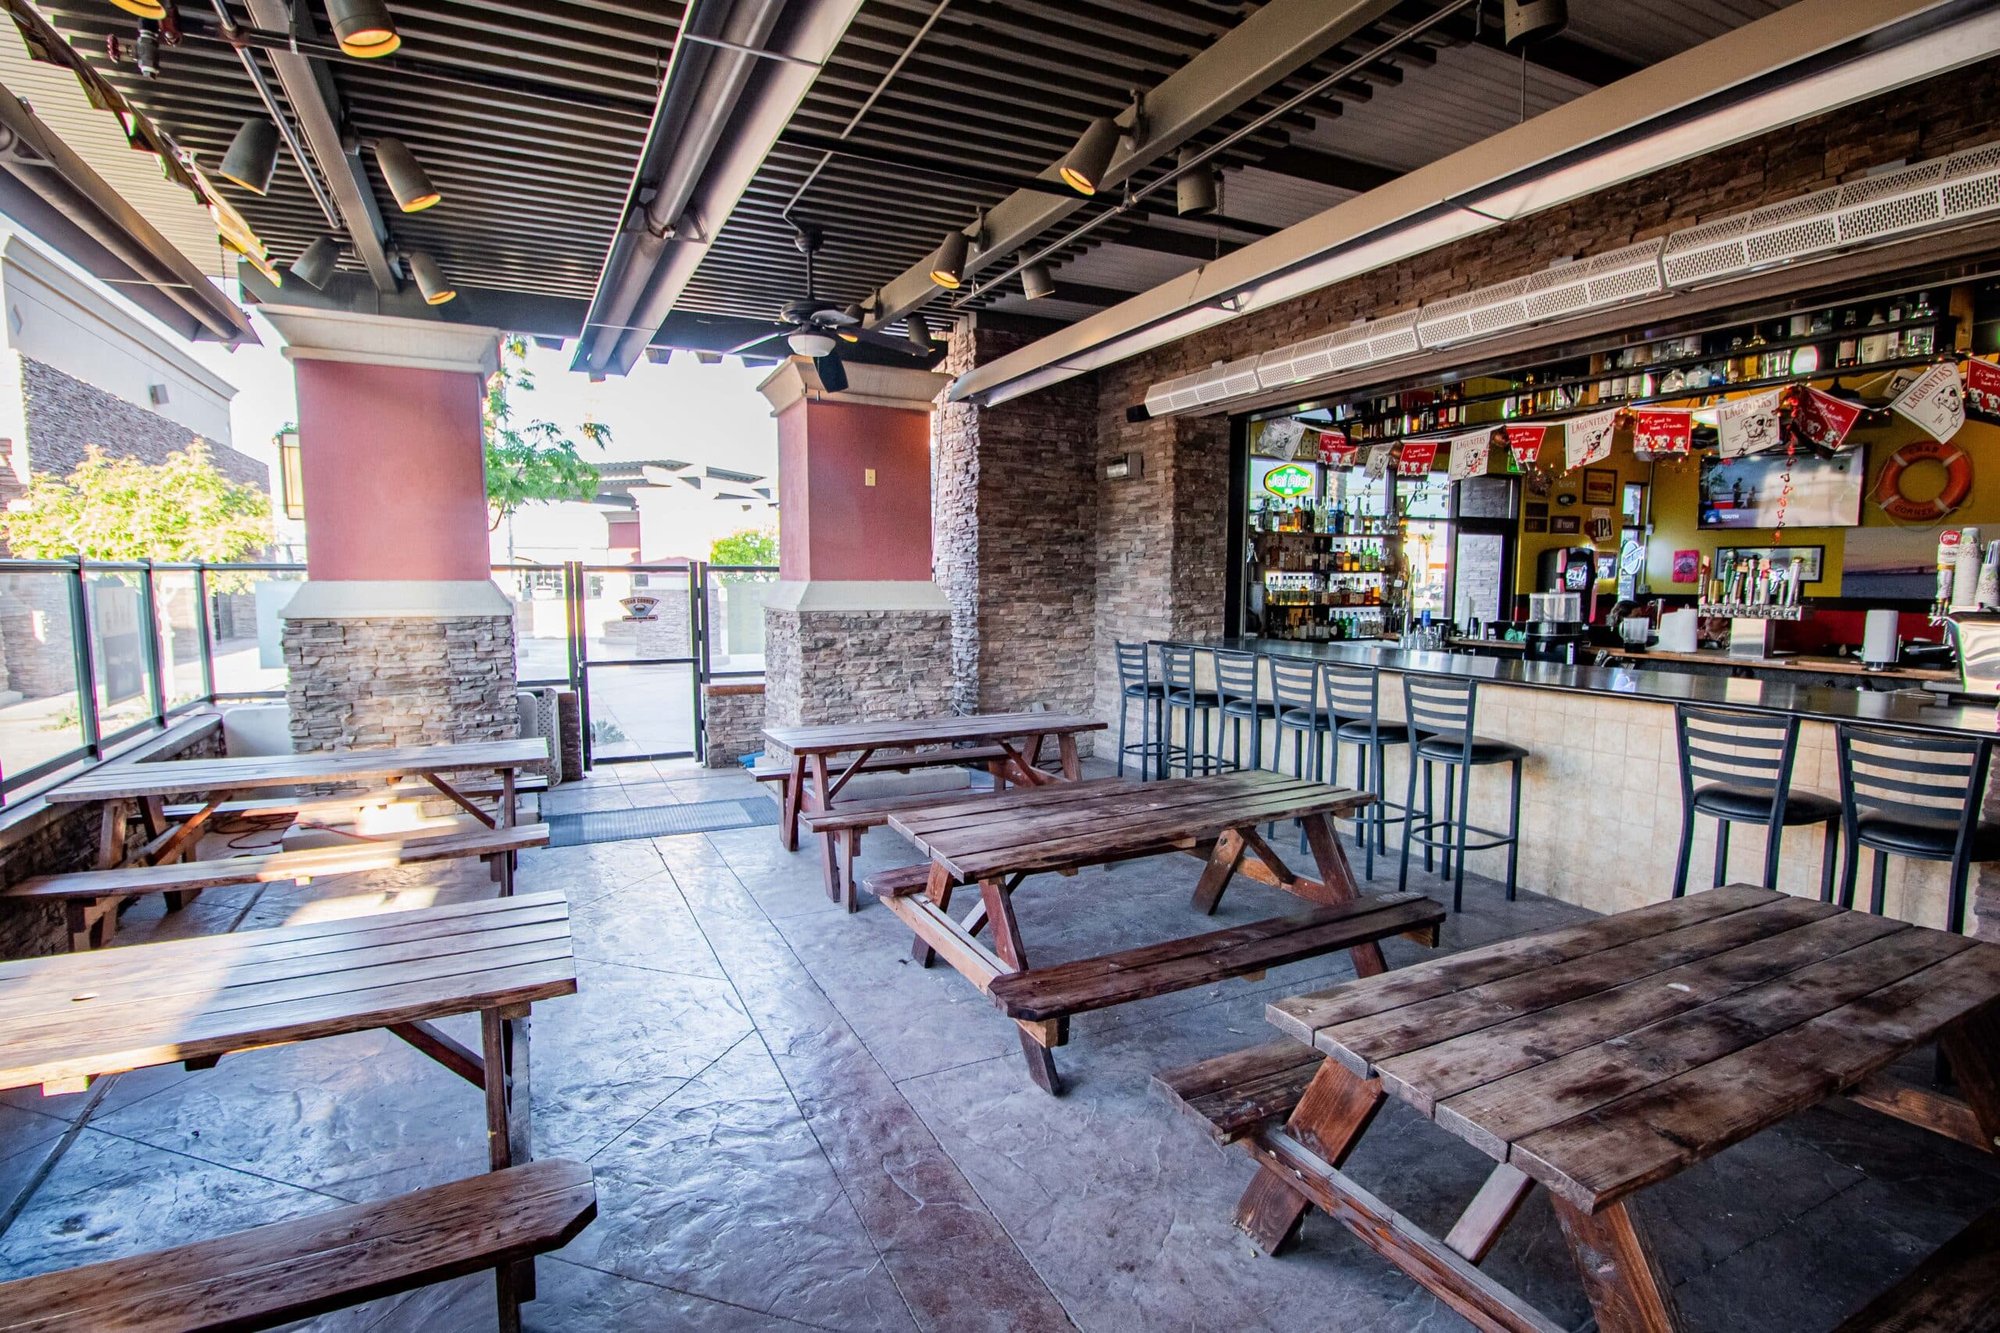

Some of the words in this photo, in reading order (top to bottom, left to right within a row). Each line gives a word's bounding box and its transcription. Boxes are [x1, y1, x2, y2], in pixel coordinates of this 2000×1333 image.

[1903, 366, 1953, 410] LAGUNITAS
[1571, 415, 1609, 434] LAGUNITAS
[1456, 436, 1485, 450] LAGUNITAS
